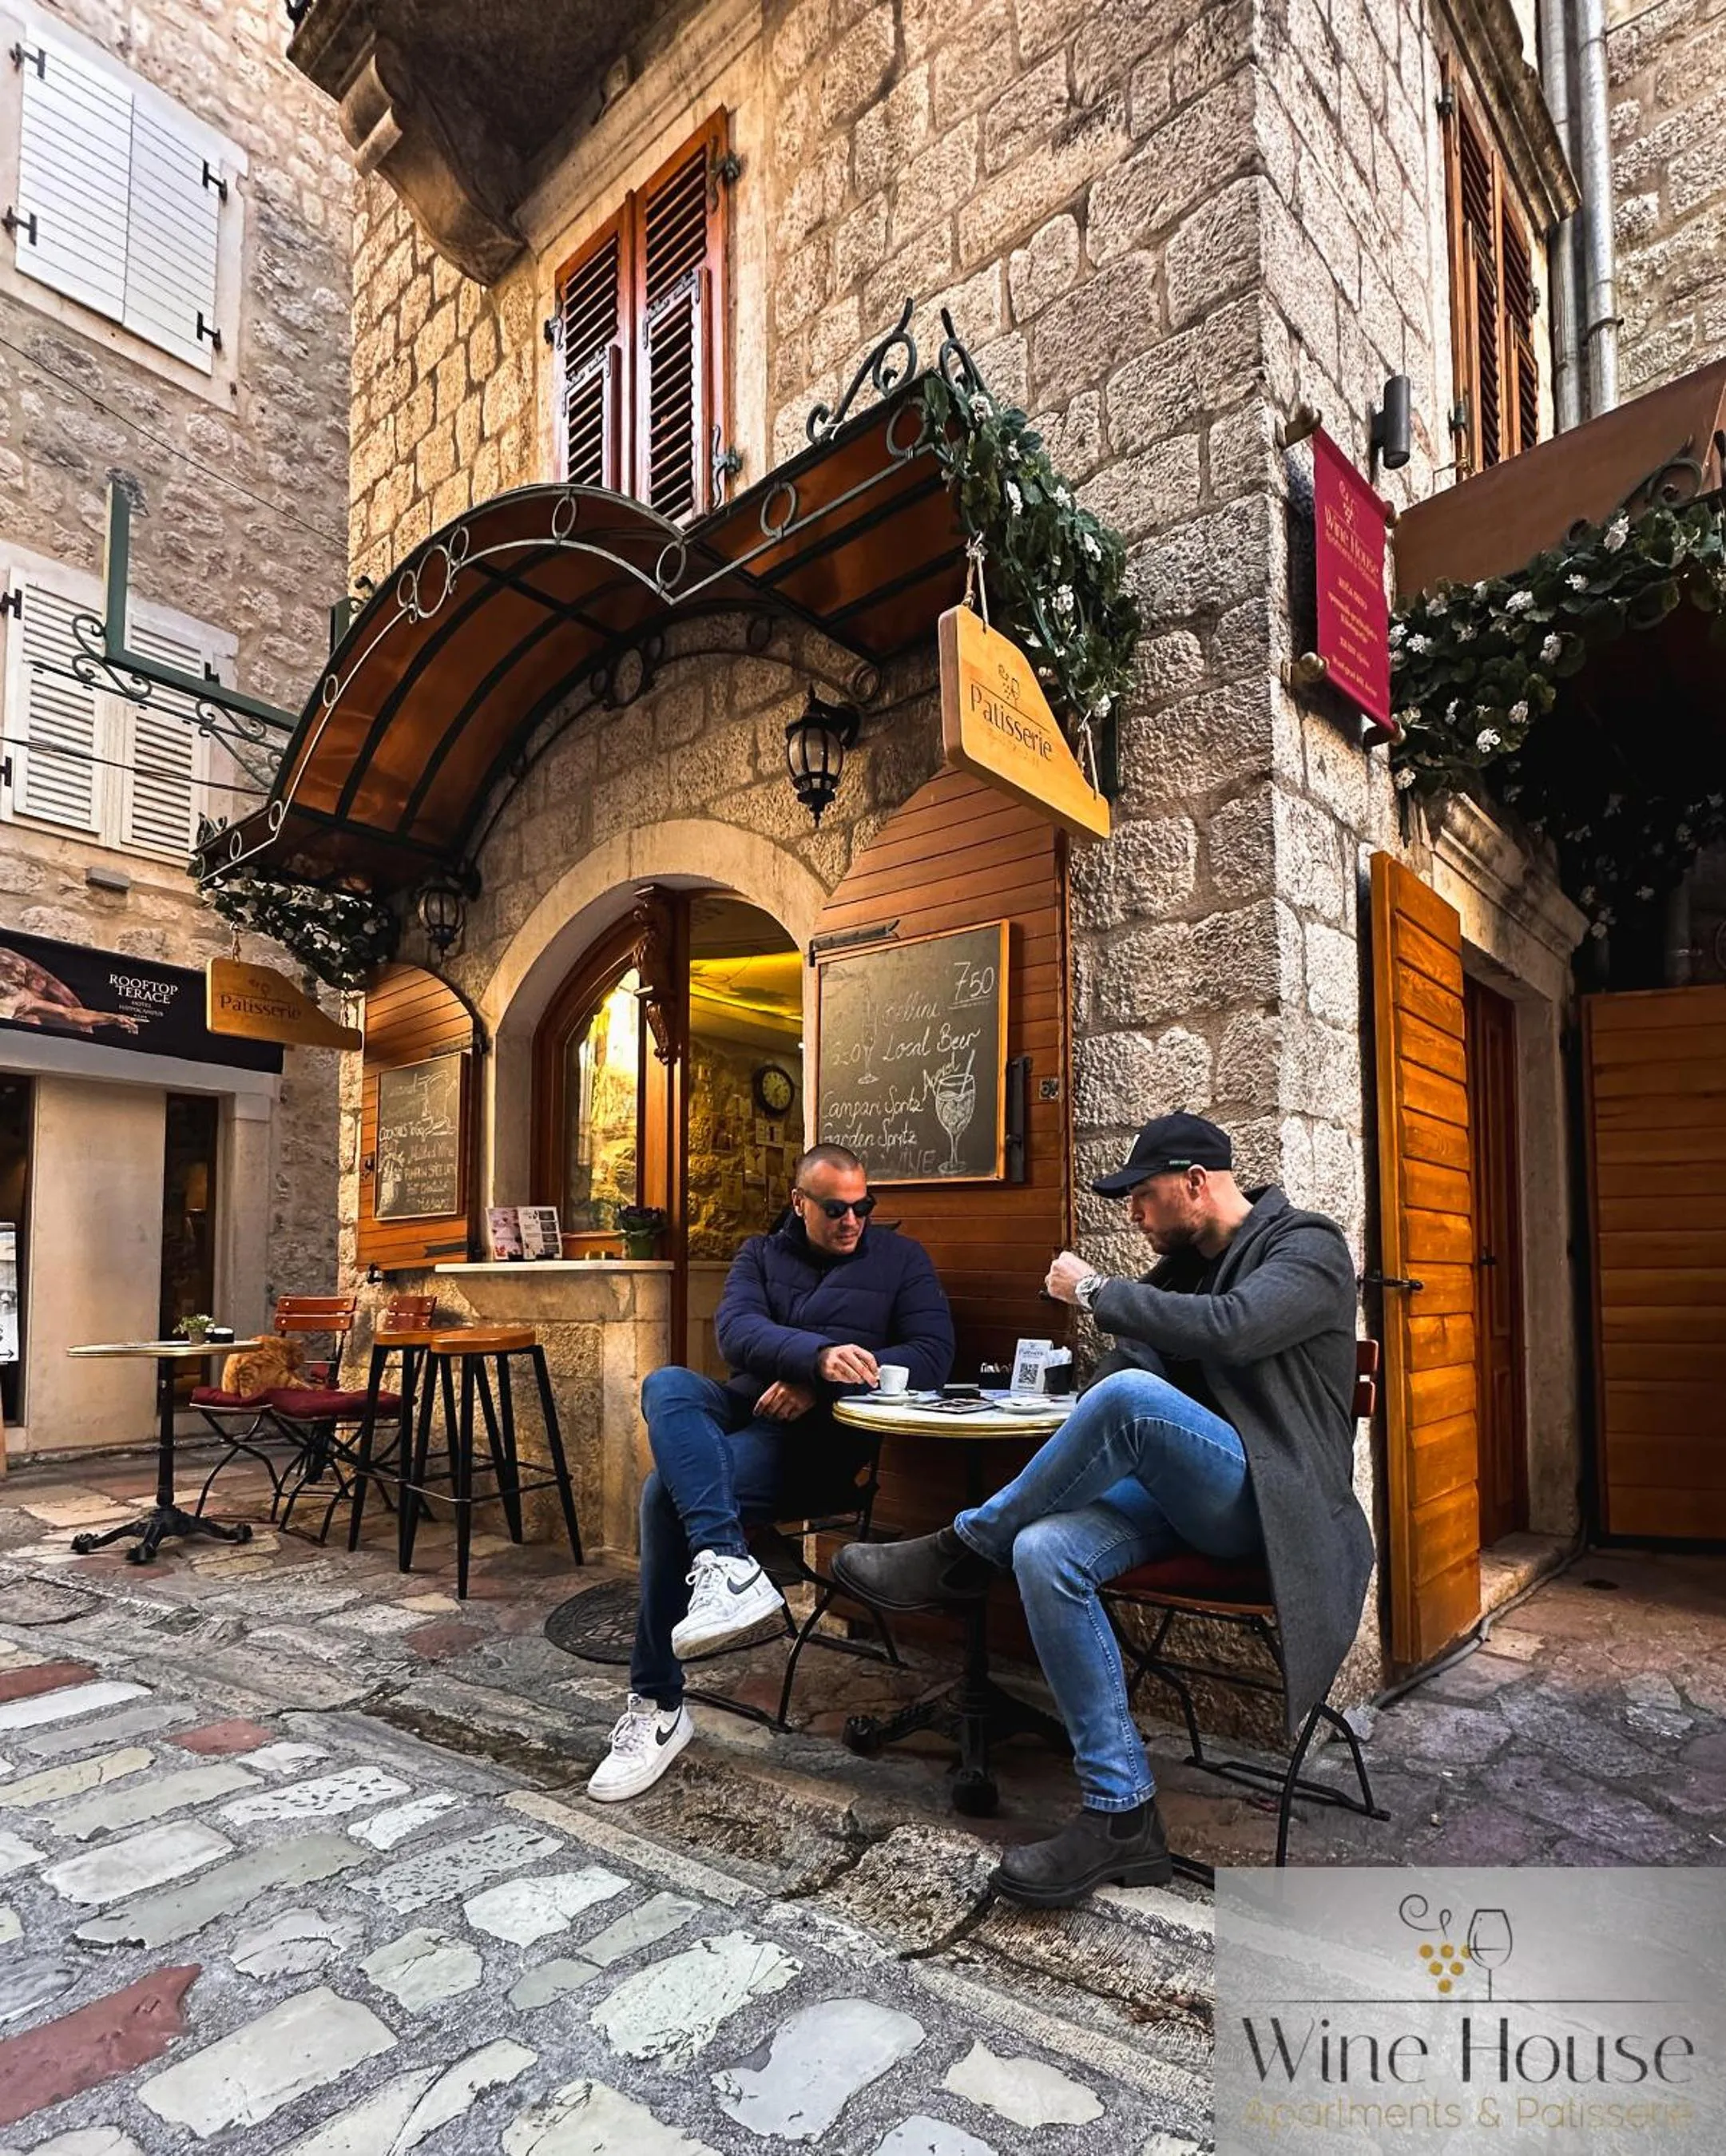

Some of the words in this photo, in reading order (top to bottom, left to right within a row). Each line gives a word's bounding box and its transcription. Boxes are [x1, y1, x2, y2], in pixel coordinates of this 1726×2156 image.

[970, 684, 1053, 761] Patisserie
[109, 974, 178, 995] ROOFTOP
[117, 985, 171, 1004] TERACE
[953, 961, 994, 999] 750
[220, 994, 302, 1019] Patisserie
[882, 1026, 932, 1061] Local
[936, 1022, 982, 1052] Beer
